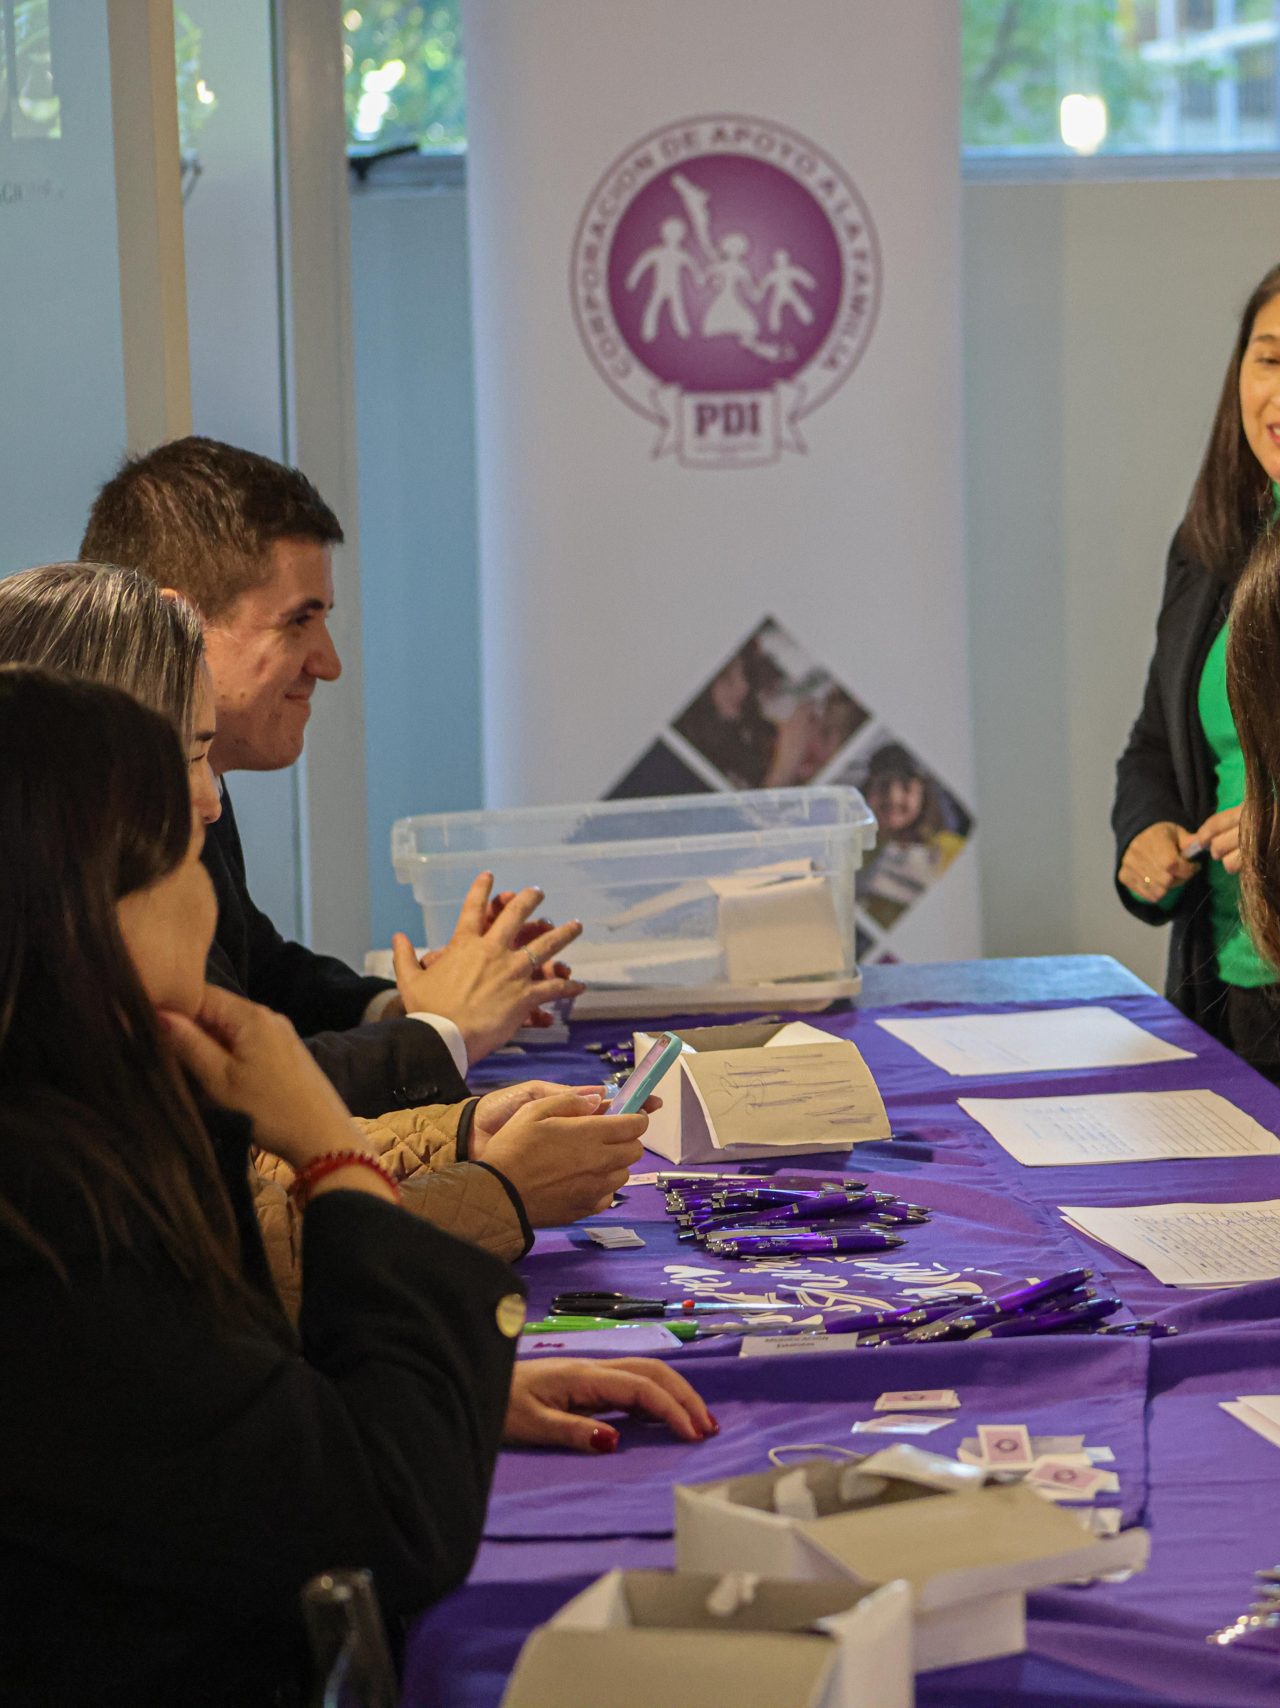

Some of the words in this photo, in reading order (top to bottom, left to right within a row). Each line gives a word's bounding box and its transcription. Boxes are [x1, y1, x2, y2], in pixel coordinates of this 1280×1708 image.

[659, 130, 695, 160] DE
[712, 126, 818, 177] APOYO
[696, 401, 761, 437] PDI
